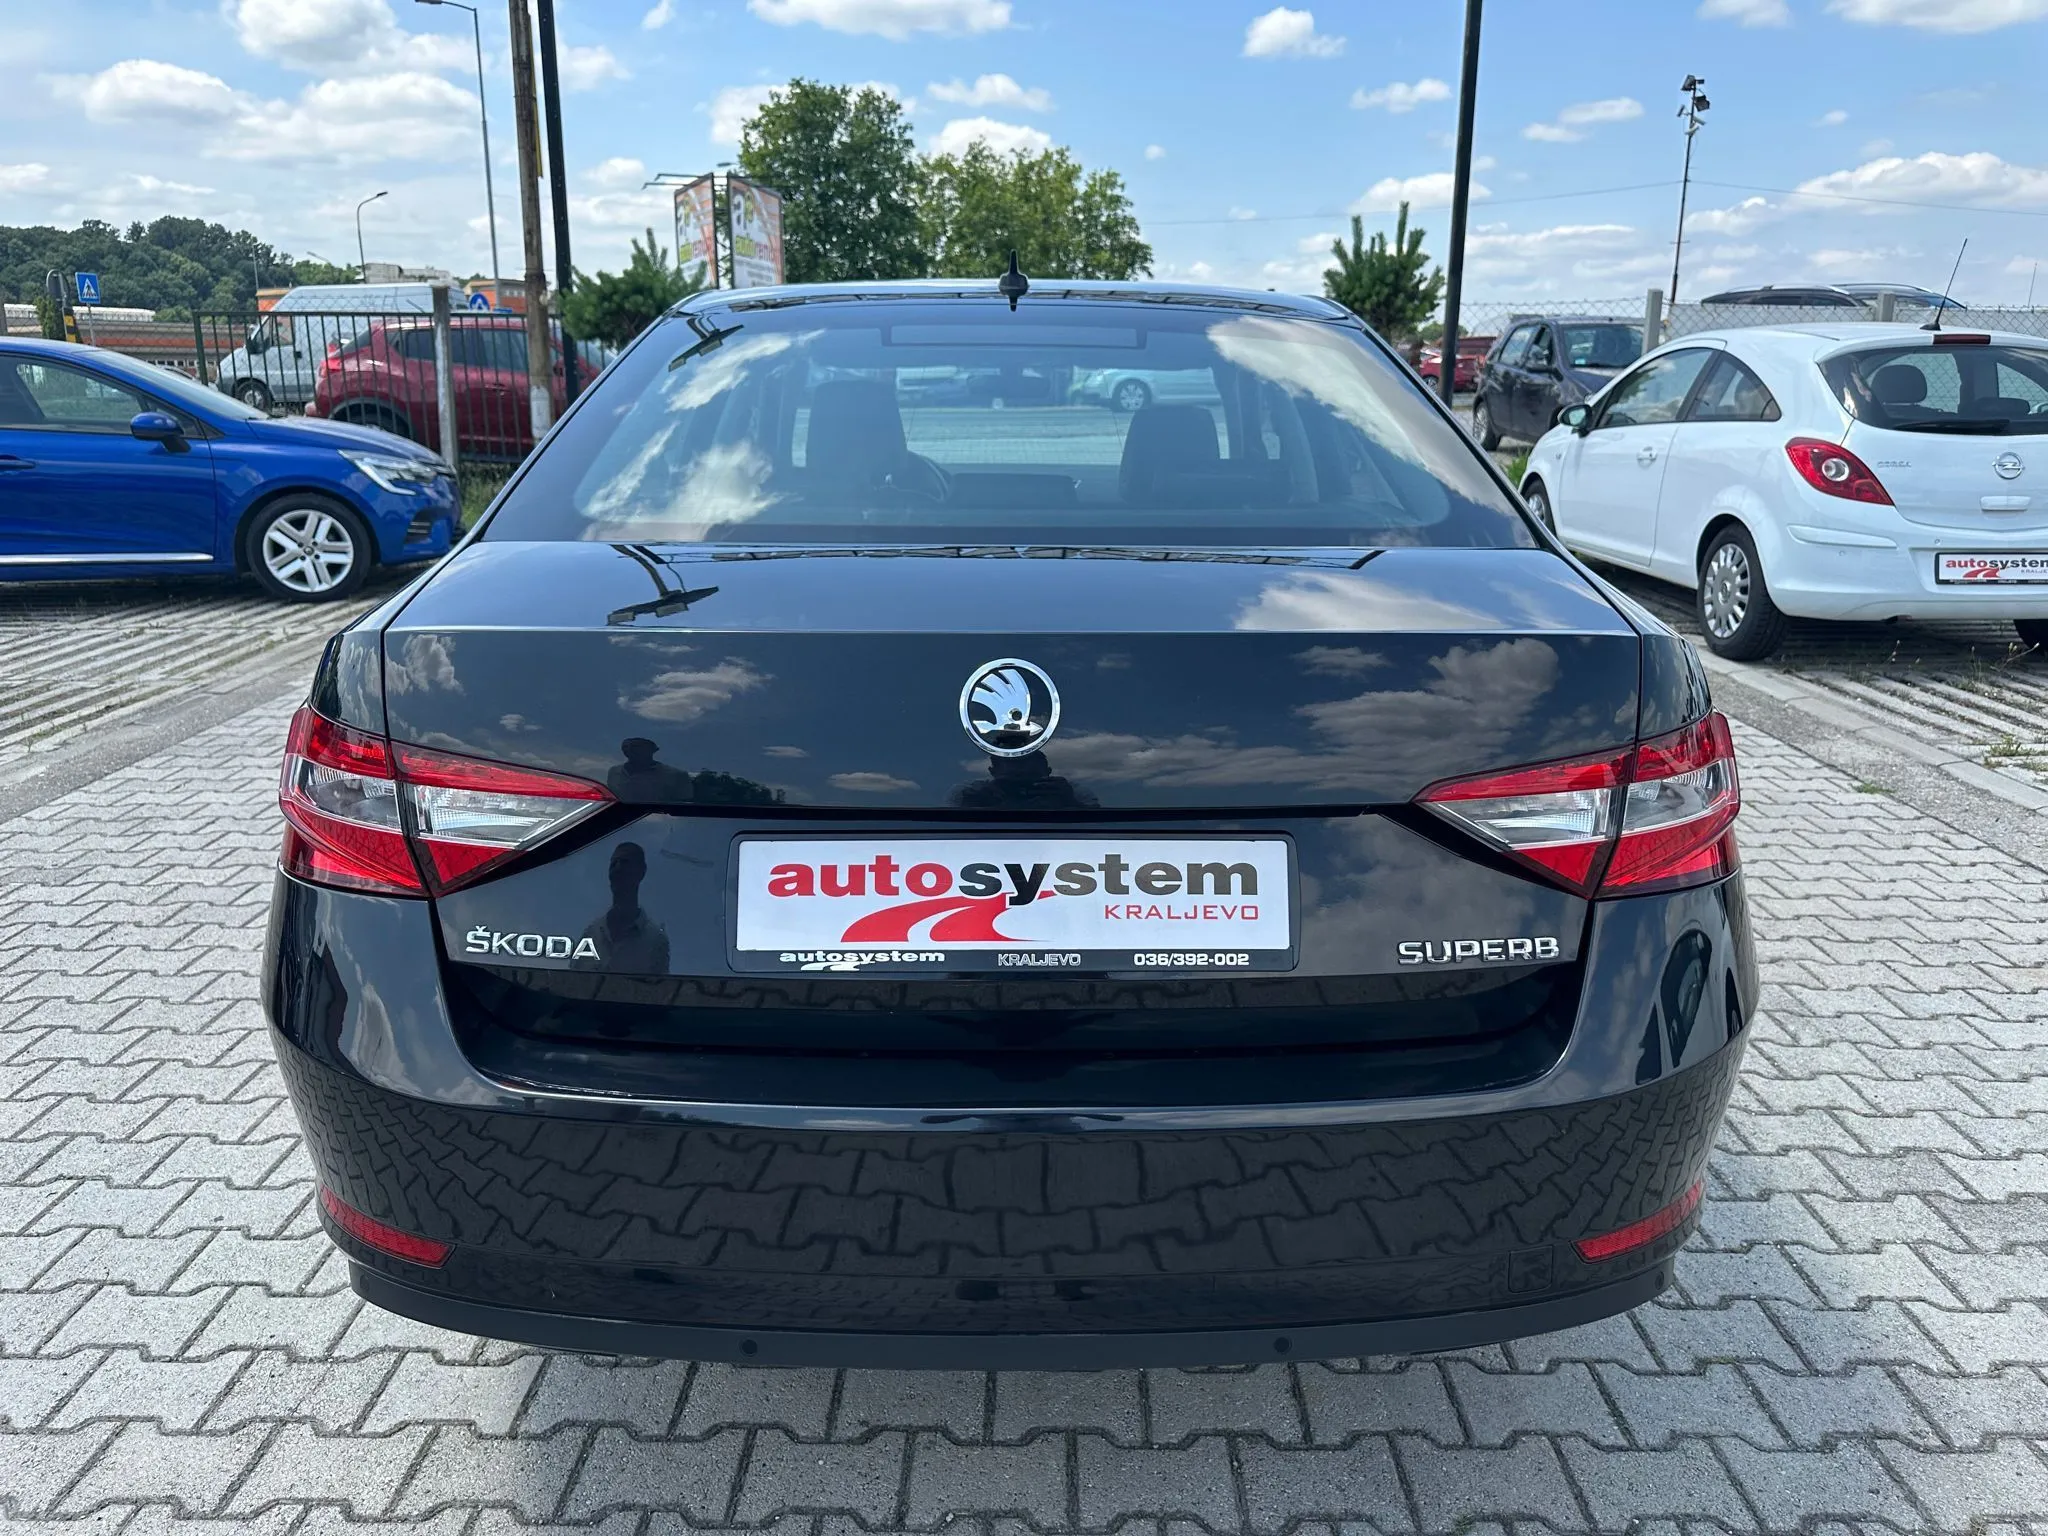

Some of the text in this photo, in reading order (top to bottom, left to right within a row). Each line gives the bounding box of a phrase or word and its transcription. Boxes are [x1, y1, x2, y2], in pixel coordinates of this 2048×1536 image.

[767, 854, 1259, 906] autosystem
[1104, 905, 1259, 920] KRALJEVO
[465, 925, 601, 961] ŠKODA
[1398, 936, 1560, 965] SUPERB
[779, 950, 1250, 966] autosystem KRALJEVO 036/392-002
